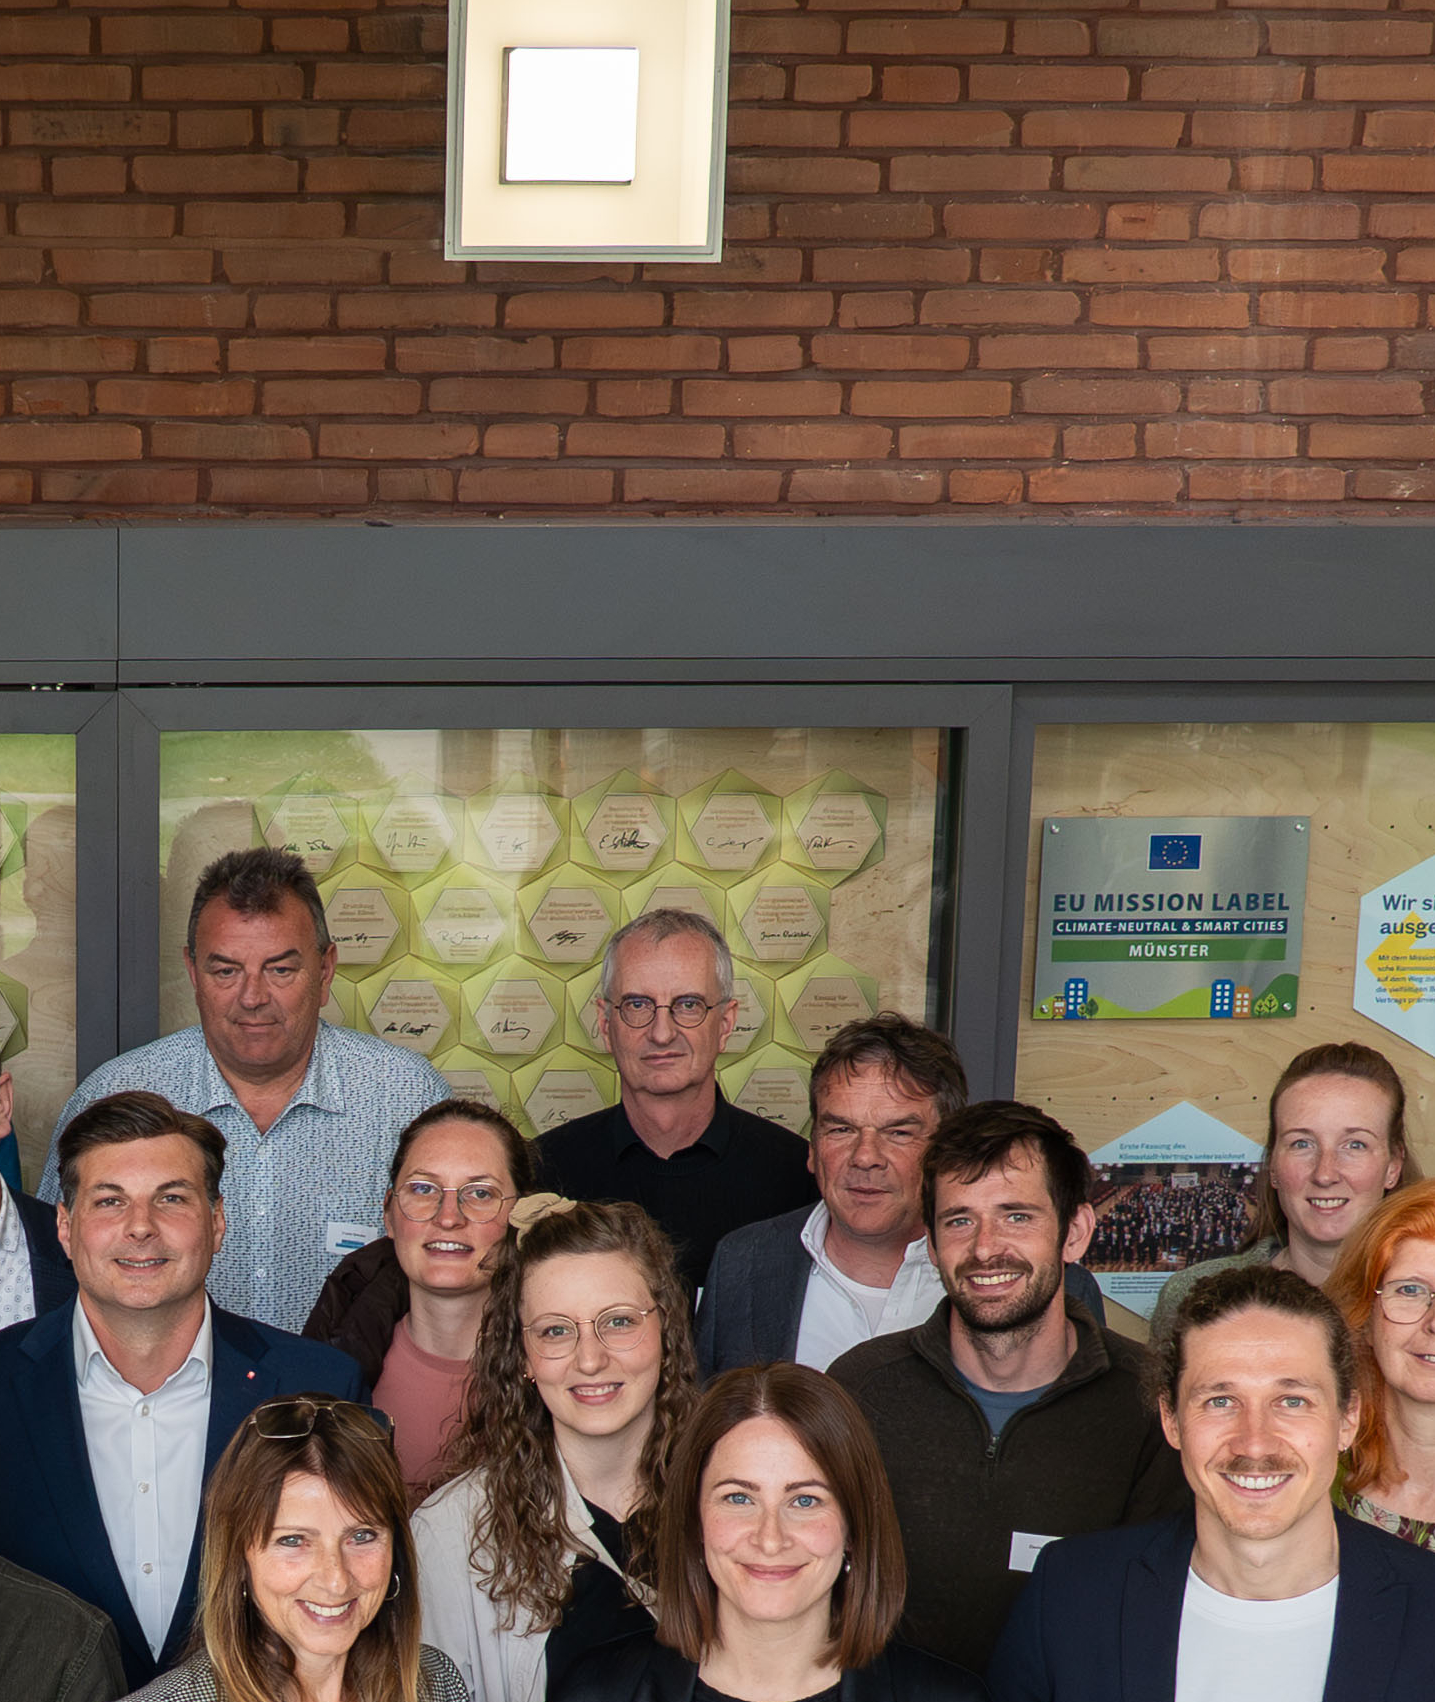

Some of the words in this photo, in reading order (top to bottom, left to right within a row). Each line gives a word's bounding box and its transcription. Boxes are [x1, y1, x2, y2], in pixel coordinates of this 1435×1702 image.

[1053, 893, 1085, 912] EU
[1094, 893, 1204, 912] MISSION
[1211, 892, 1290, 911] LABEL
[1382, 894, 1417, 911] Wir
[1056, 922, 1177, 932] CLIMATE-NEUTRAL
[1181, 921, 1191, 932] &
[1194, 921, 1239, 932] SMART
[1243, 920, 1285, 931] CITIES
[1129, 943, 1209, 957] MÜNSTER
